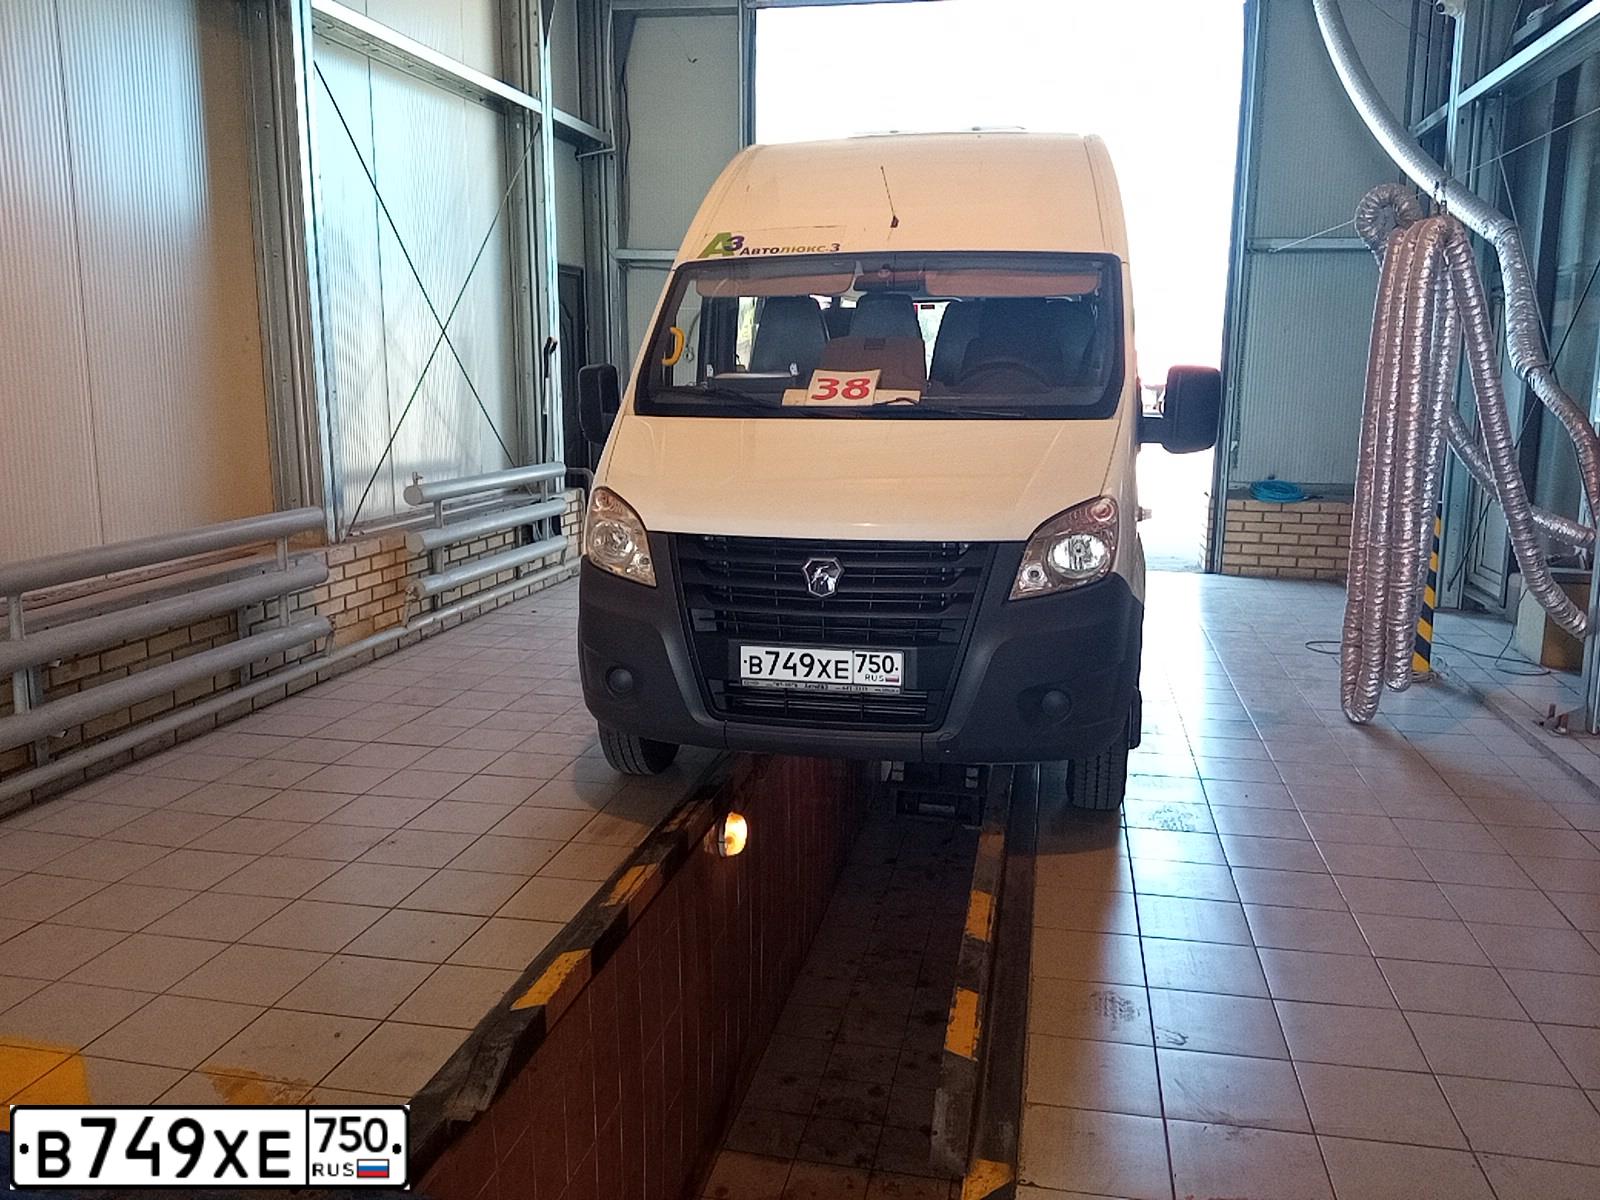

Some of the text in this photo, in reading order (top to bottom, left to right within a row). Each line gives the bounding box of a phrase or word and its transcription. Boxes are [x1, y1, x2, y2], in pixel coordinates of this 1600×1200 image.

[811, 378, 871, 401] 38
[856, 653, 895, 674] 750
[864, 673, 884, 682] RUS
